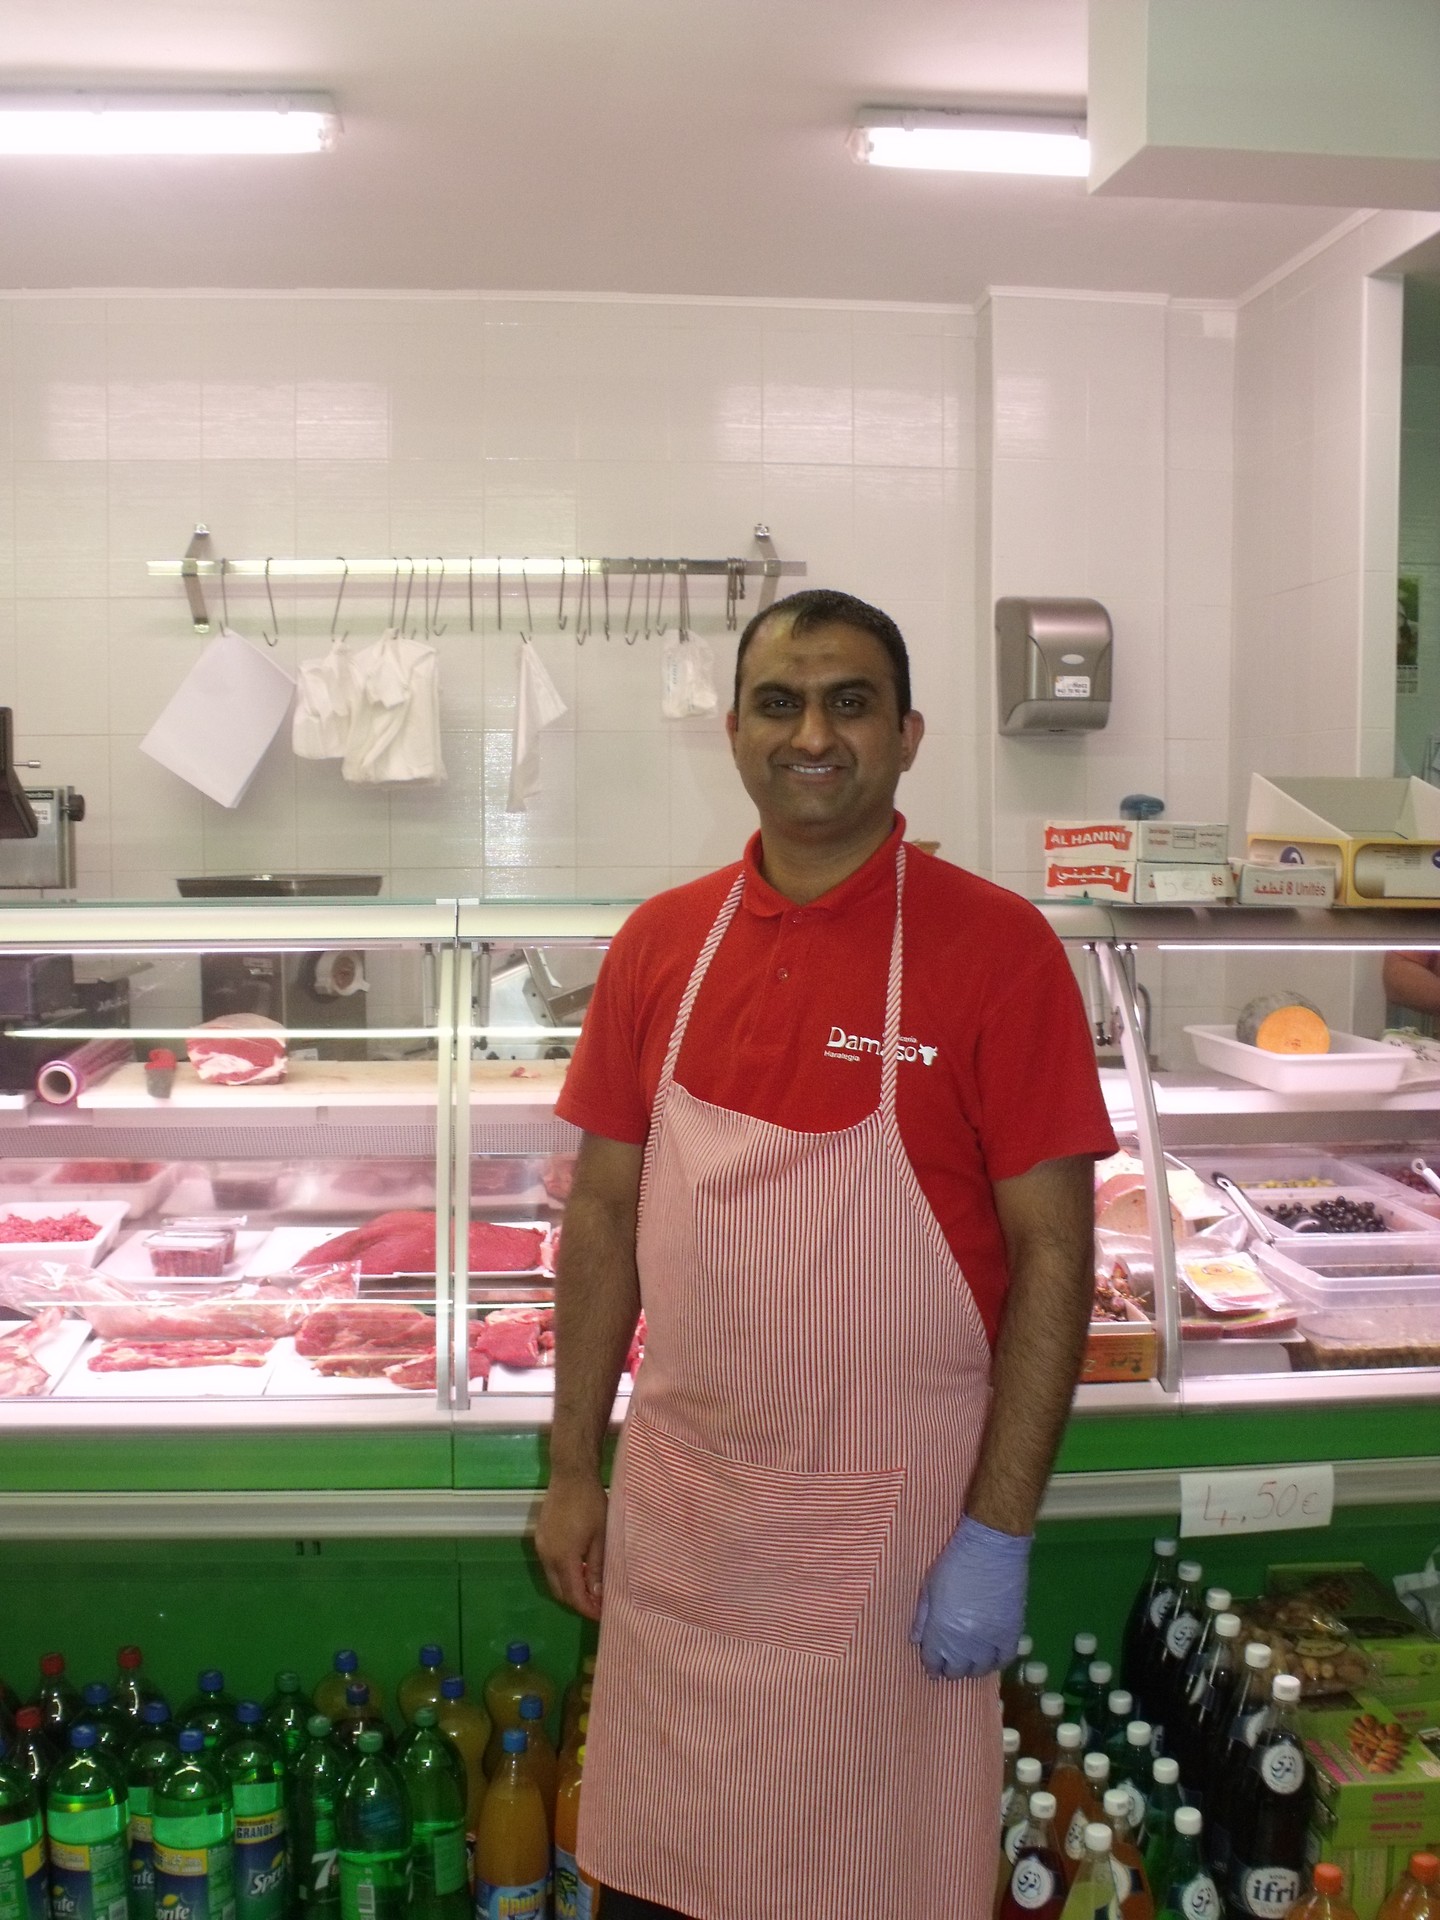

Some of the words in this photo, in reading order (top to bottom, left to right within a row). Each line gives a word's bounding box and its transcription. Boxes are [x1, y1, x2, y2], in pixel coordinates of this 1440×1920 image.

[1051, 833, 1069, 846] AL
[1071, 829, 1127, 846] HANINI
[1286, 881, 1293, 895] 8
[1295, 881, 1326, 897] Unités
[826, 1026, 918, 1062] Damso
[236, 1823, 273, 1839] GRANDE
[1252, 1880, 1297, 1902] ifri
